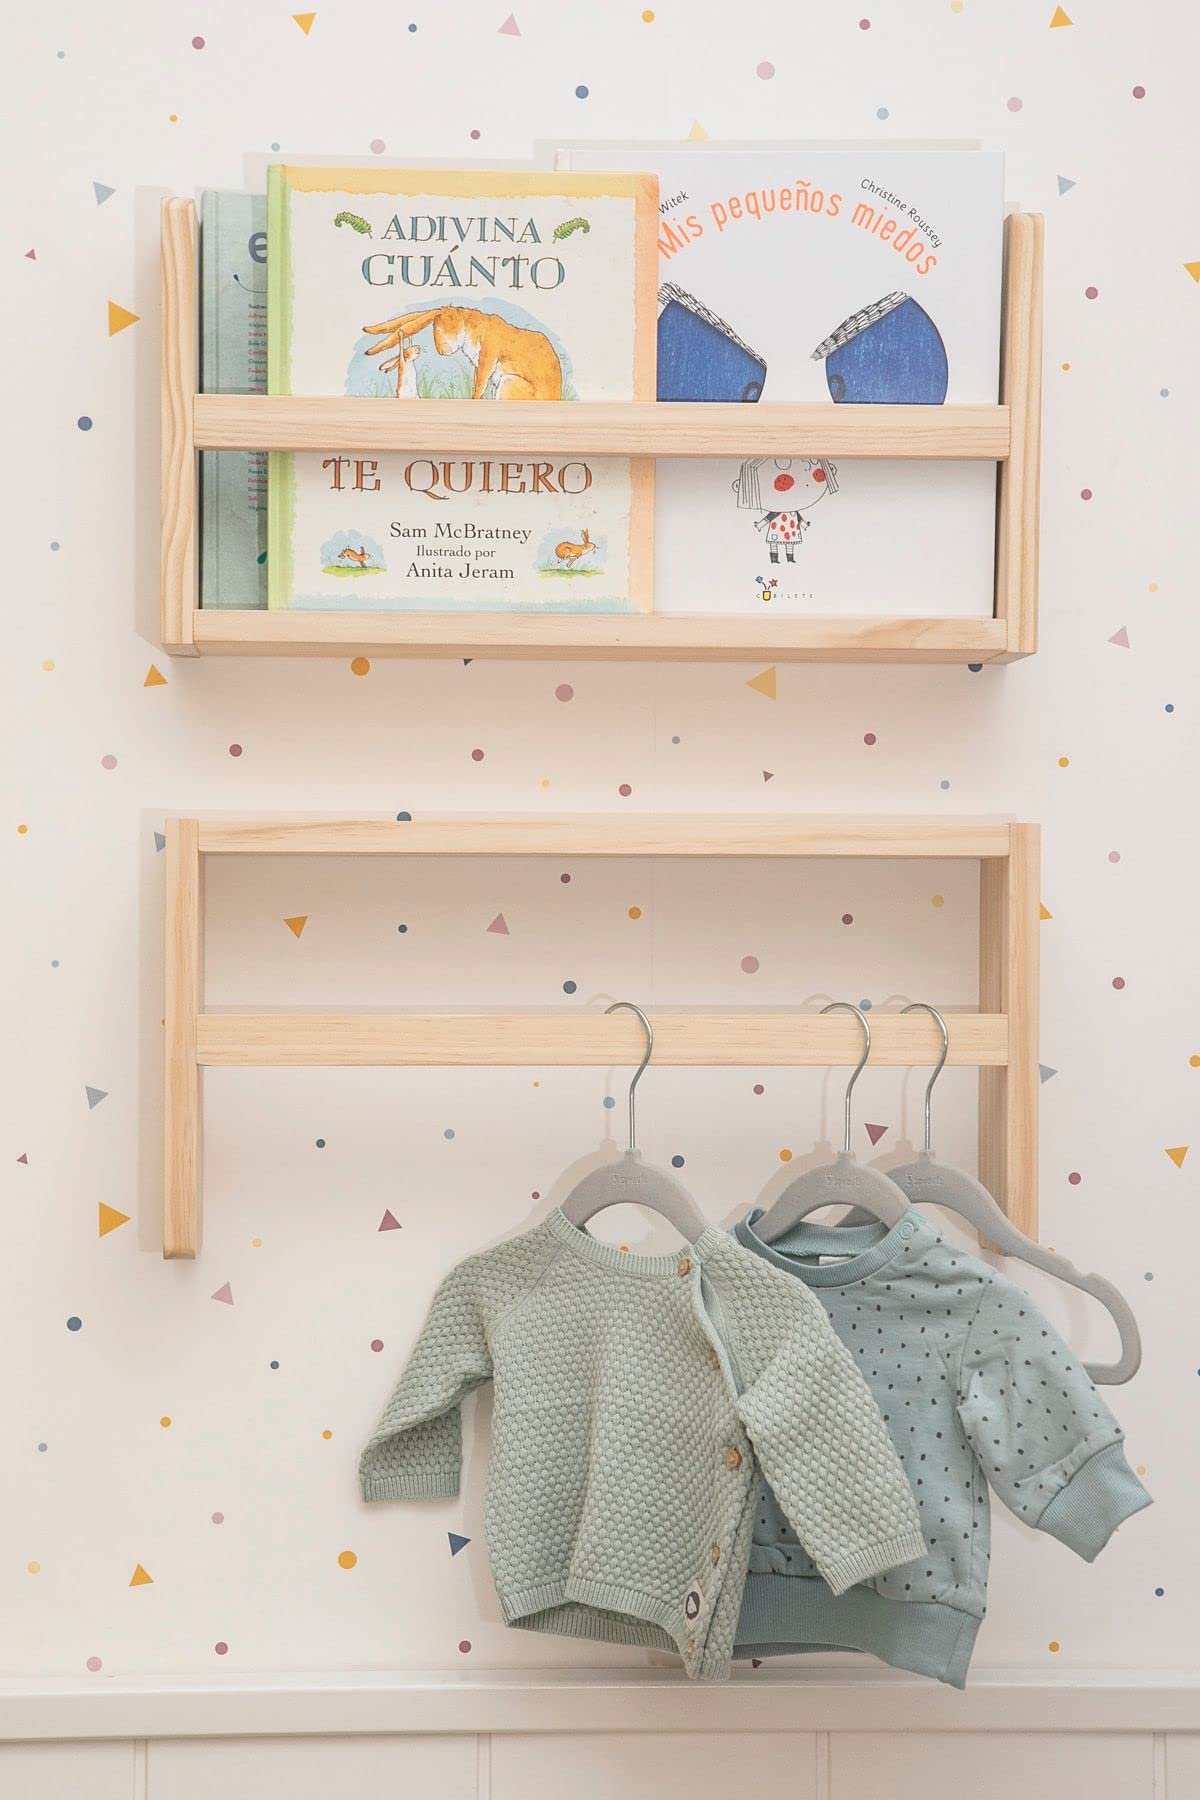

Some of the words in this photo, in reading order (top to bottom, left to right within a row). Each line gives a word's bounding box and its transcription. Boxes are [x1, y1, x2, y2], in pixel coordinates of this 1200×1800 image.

[658, 190, 690, 214] Witek
[861, 178, 907, 211] Christine
[907, 206, 943, 249] Roussey
[380, 213, 542, 244] ADIVINA
[657, 215, 704, 259] Mis
[711, 180, 843, 232] pequeños
[851, 199, 938, 277] miedos
[362, 244, 565, 290] CUÁNTO
[322, 455, 381, 492] TE
[404, 458, 593, 500] QUIERO
[390, 522, 427, 538] Sam
[434, 522, 532, 544] McBratney
[416, 545, 471, 558] Ilustrado
[475, 549, 496, 561] por
[406, 562, 453, 579] Anita
[459, 562, 515, 579] Jeram
[756, 591, 813, 601] CUBILETE
